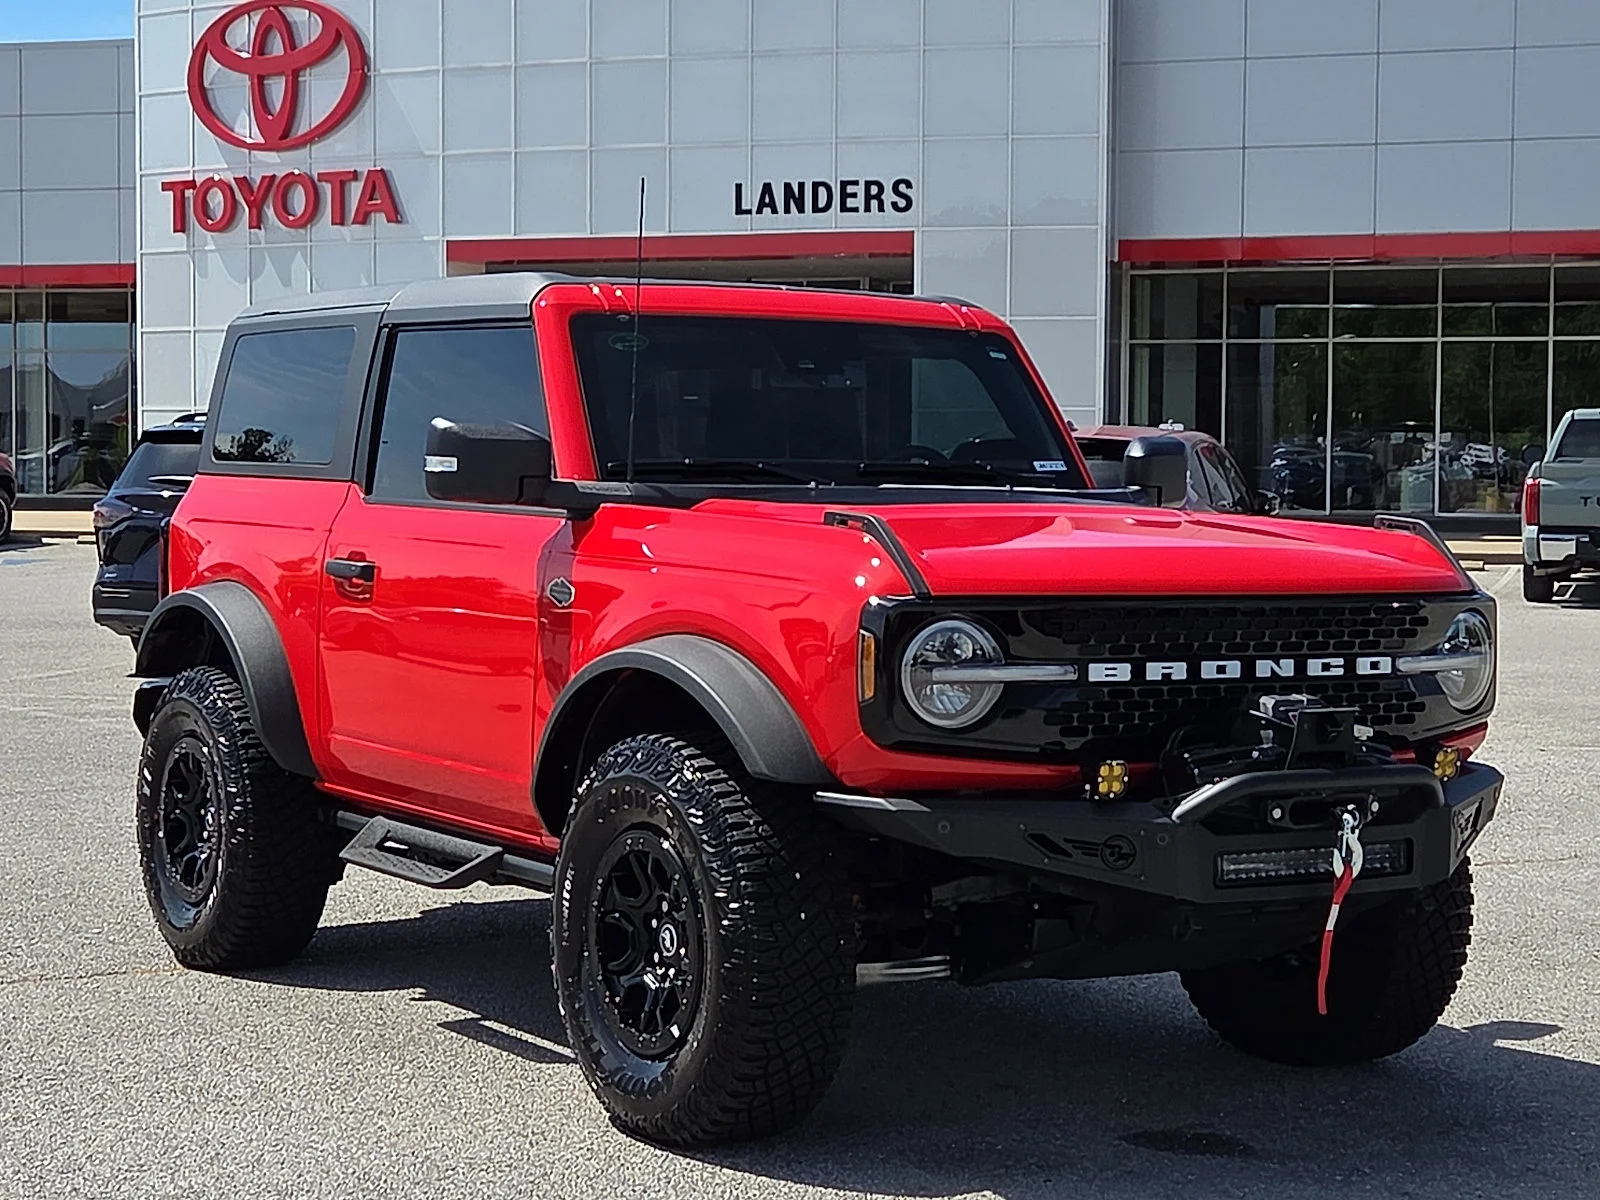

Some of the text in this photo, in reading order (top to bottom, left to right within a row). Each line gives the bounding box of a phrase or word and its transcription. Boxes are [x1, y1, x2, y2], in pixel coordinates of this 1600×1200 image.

[161, 168, 403, 234] TOYOTA
[735, 178, 914, 215] LANDERS
[1088, 656, 1393, 682] BRONCO
